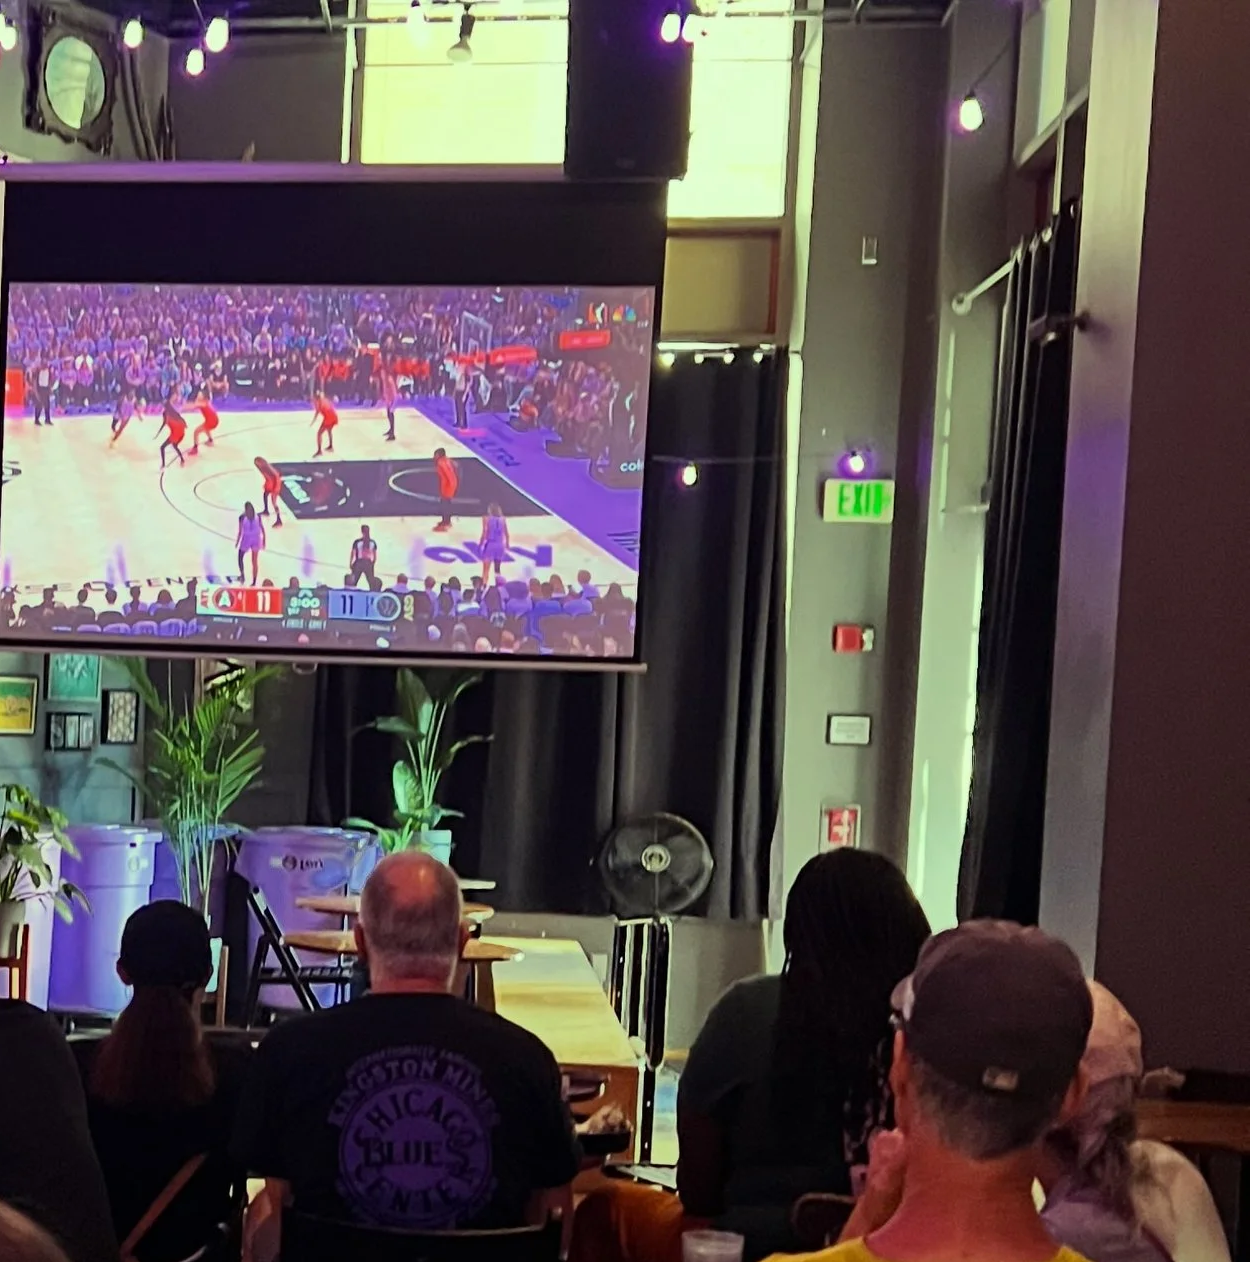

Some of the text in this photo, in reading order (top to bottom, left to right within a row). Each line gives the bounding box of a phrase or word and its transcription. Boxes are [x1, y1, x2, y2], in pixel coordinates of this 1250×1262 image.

[838, 482, 883, 517] EXIT
[257, 591, 271, 613] 11
[341, 594, 354, 615] 11
[354, 1090, 477, 1148] CHICAGO
[364, 1128, 470, 1178] BLUES
[355, 1164, 481, 1213] CENTER
